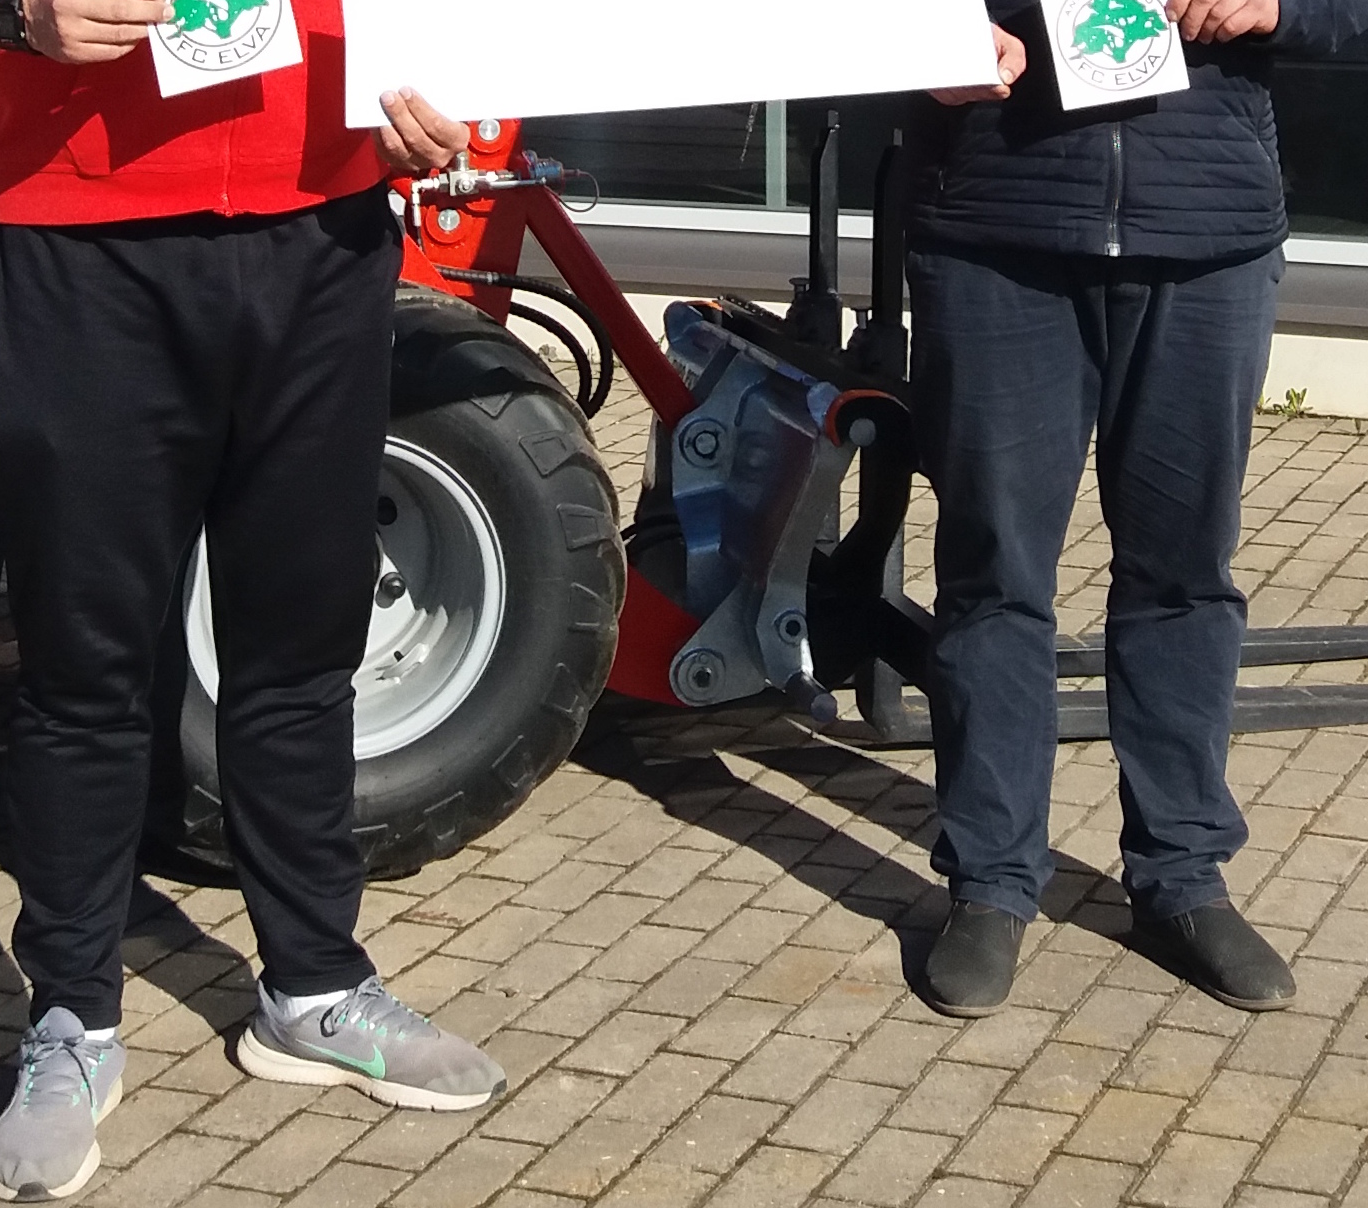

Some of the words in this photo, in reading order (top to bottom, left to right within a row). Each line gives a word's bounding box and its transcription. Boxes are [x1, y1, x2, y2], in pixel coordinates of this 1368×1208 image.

[177, 39, 208, 64] FC
[218, 26, 271, 64] ELVA
[1078, 61, 1105, 84] FC
[1115, 54, 1162, 86] ELVA
